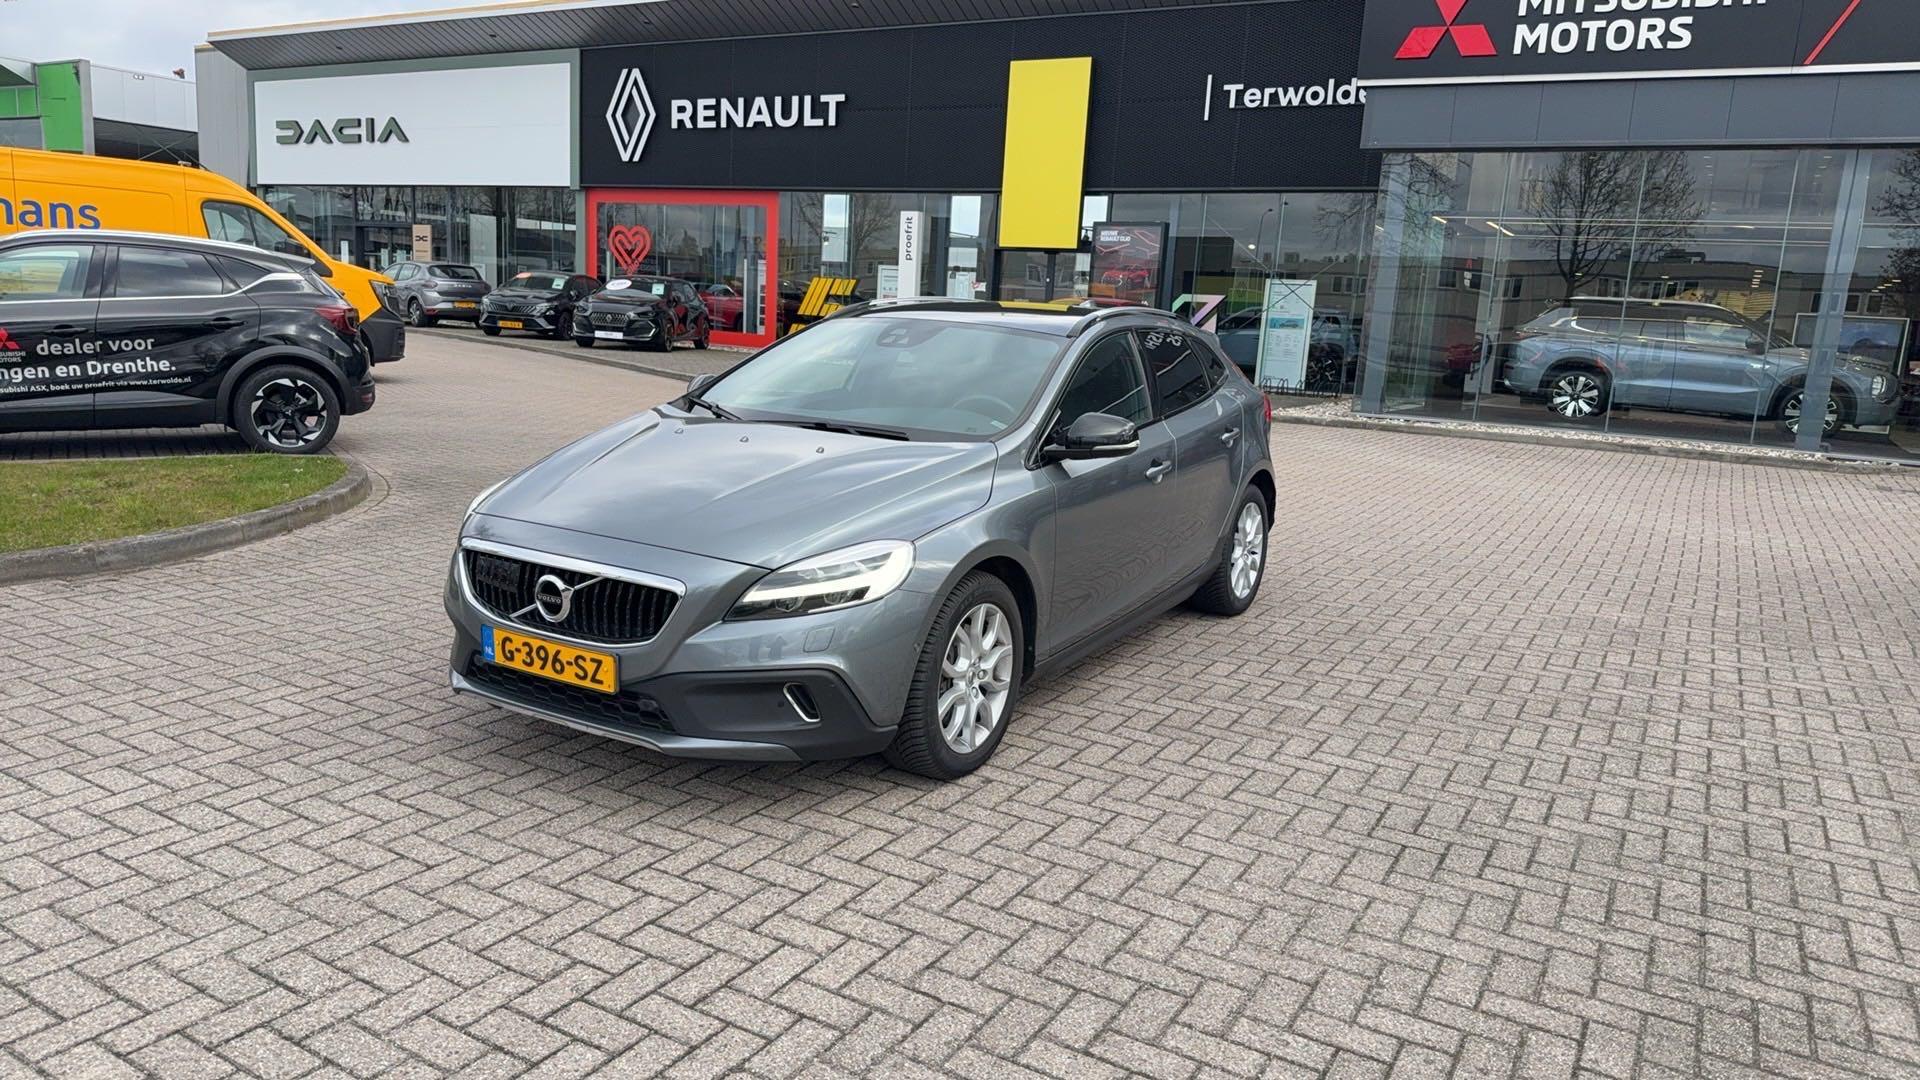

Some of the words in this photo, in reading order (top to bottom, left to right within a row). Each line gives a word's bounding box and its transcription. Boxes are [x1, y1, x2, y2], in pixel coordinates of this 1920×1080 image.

[1513, 16, 1694, 55] MOTORS
[671, 94, 846, 129] RENAULT
[276, 117, 409, 144] DACIA
[905, 216, 913, 261] proefrit
[36, 338, 103, 355] dealer
[107, 338, 156, 352] voor
[55, 364, 81, 377] en
[87, 357, 177, 376] Drenthe.
[30, 384, 49, 392] ASX,
[50, 383, 70, 391] boek
[128, 376, 192, 386] www.terwolde.nl
[537, 593, 561, 604] VOLVO
[484, 645, 495, 656] NL
[501, 636, 604, 685] G-396-SZ
